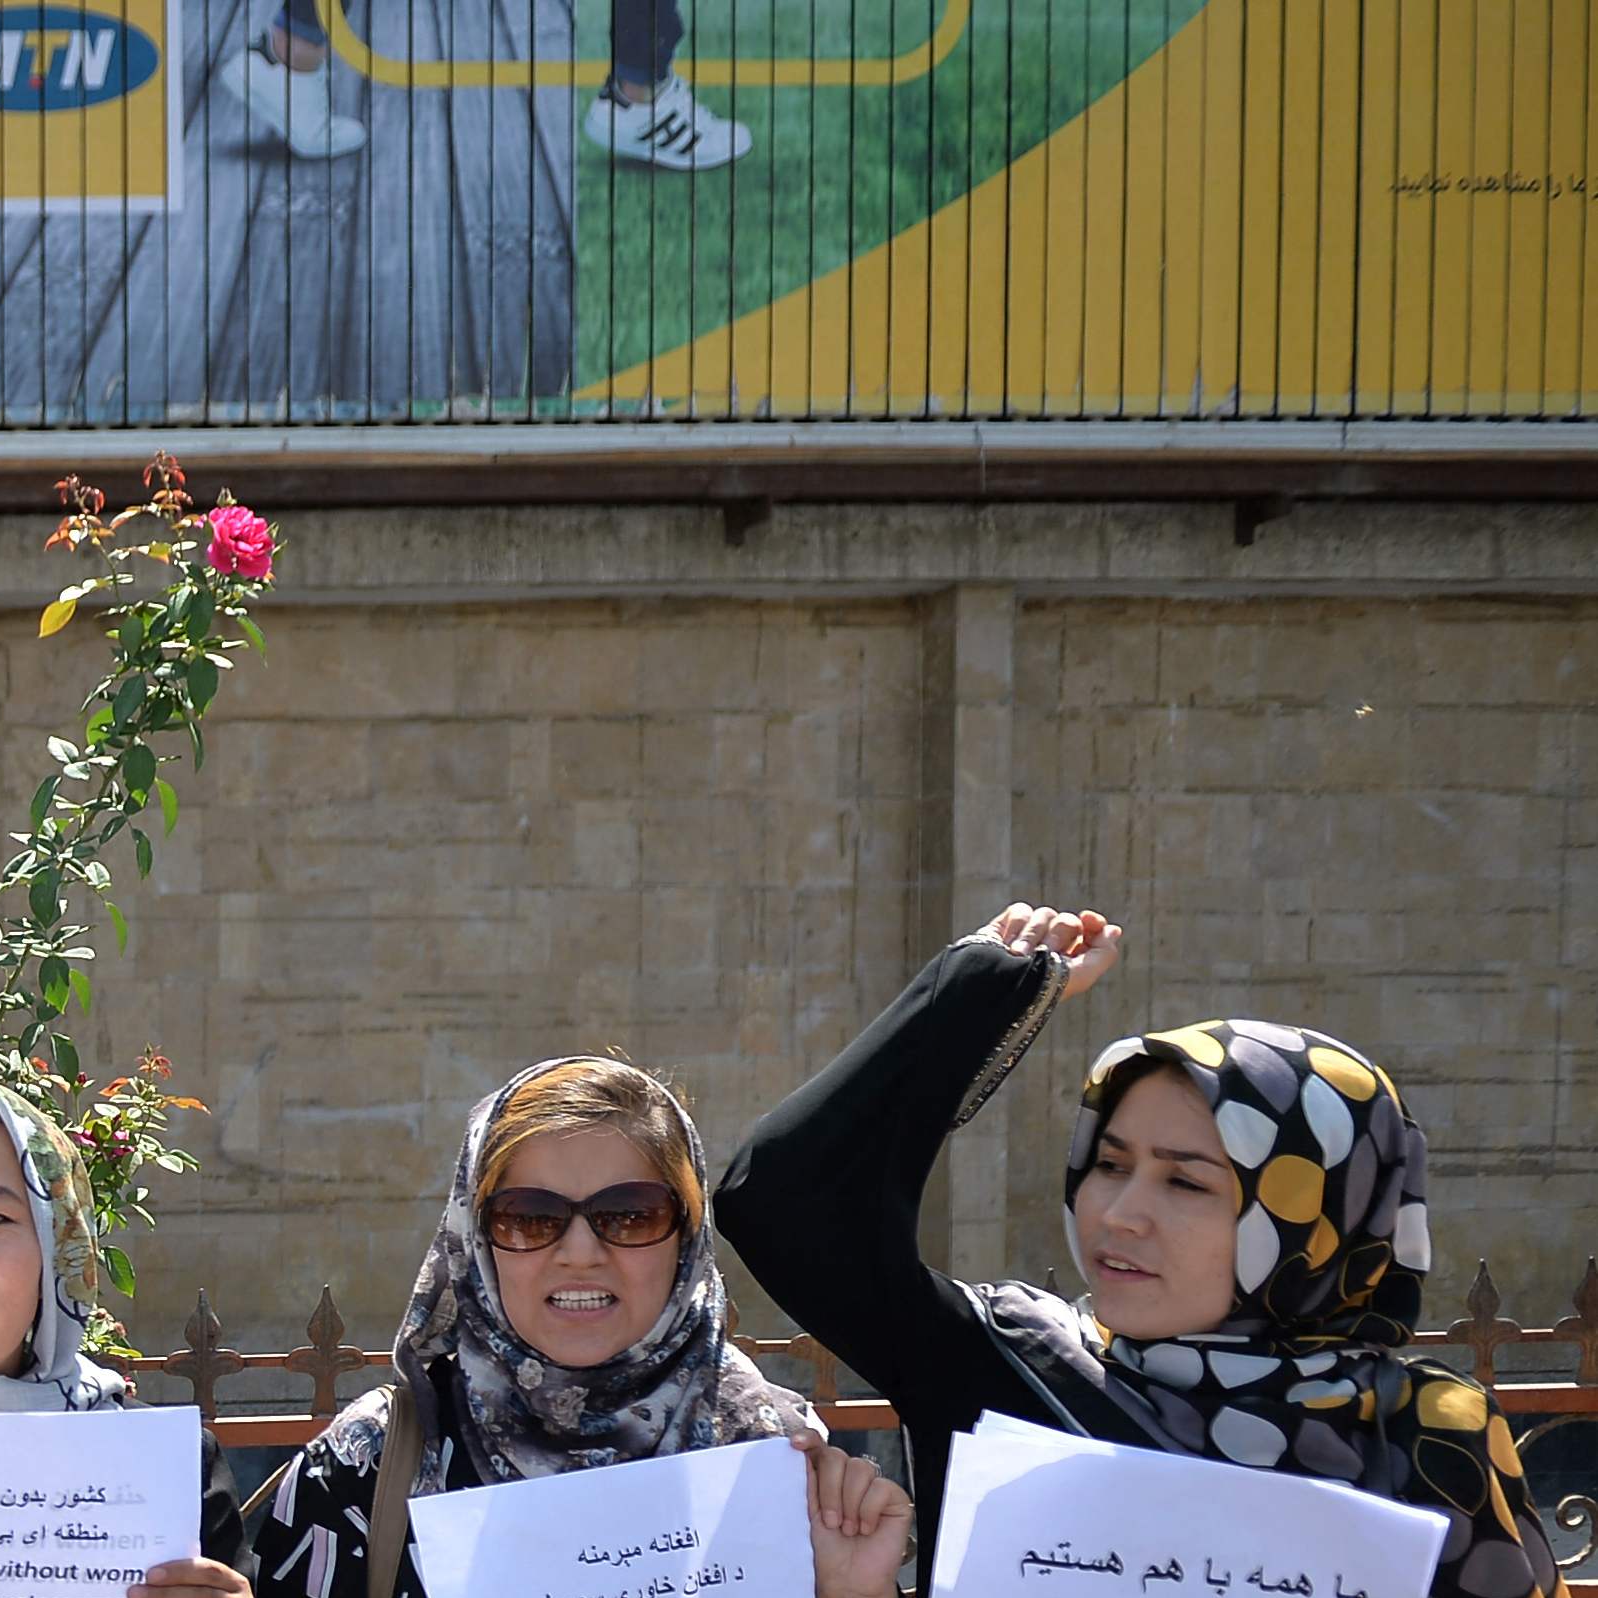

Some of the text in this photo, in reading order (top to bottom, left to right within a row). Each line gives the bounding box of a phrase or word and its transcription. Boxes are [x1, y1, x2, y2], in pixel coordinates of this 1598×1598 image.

[52, 1485, 107, 1511] کشور
[21, 1524, 47, 1546] ای
[55, 1525, 108, 1541] منطقه
[734, 1566, 744, 1581] د
[1020, 1541, 1125, 1578] هستیم
[87, 1567, 143, 1584] wom
[682, 1563, 727, 1596] افغان
[1141, 1558, 1184, 1593] هم
[1205, 1557, 1232, 1596] با
[1245, 1567, 1314, 1598] همه
